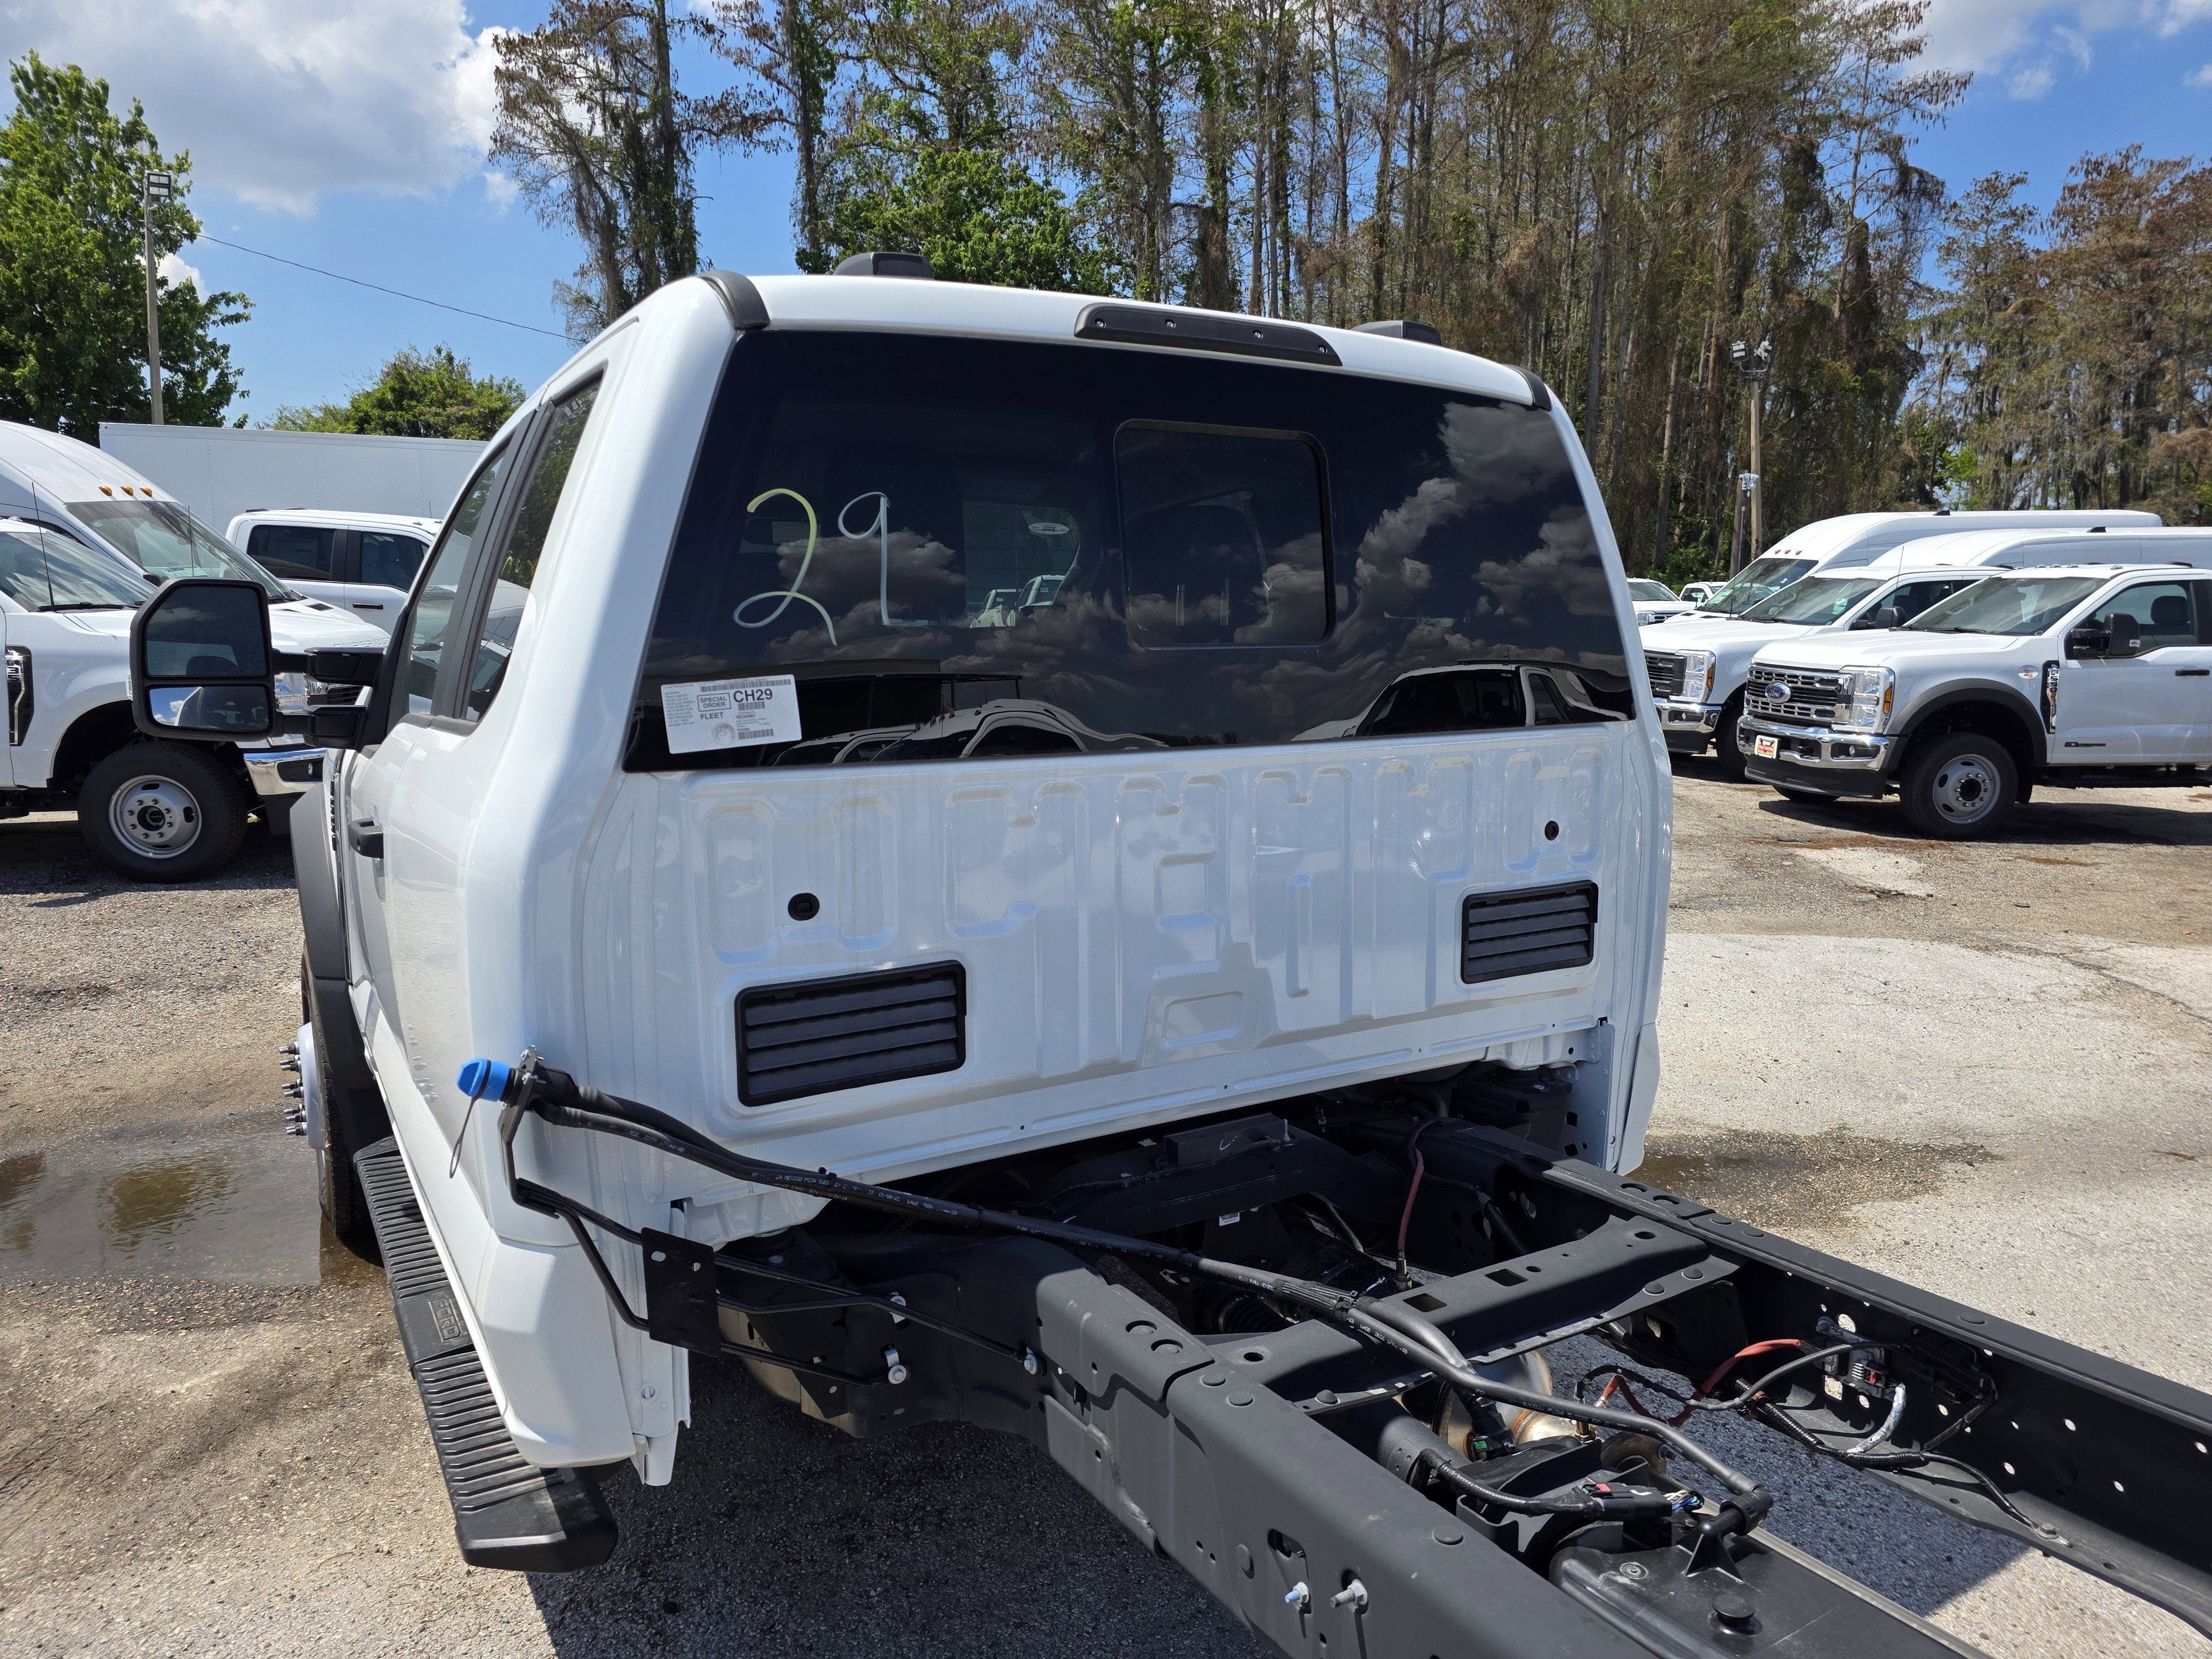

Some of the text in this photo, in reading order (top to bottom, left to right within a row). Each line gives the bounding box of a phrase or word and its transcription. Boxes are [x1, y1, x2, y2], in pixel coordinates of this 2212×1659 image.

[733, 488, 891, 646] 29
[733, 688, 773, 703] CH29
[432, 1297, 462, 1340] FORD
